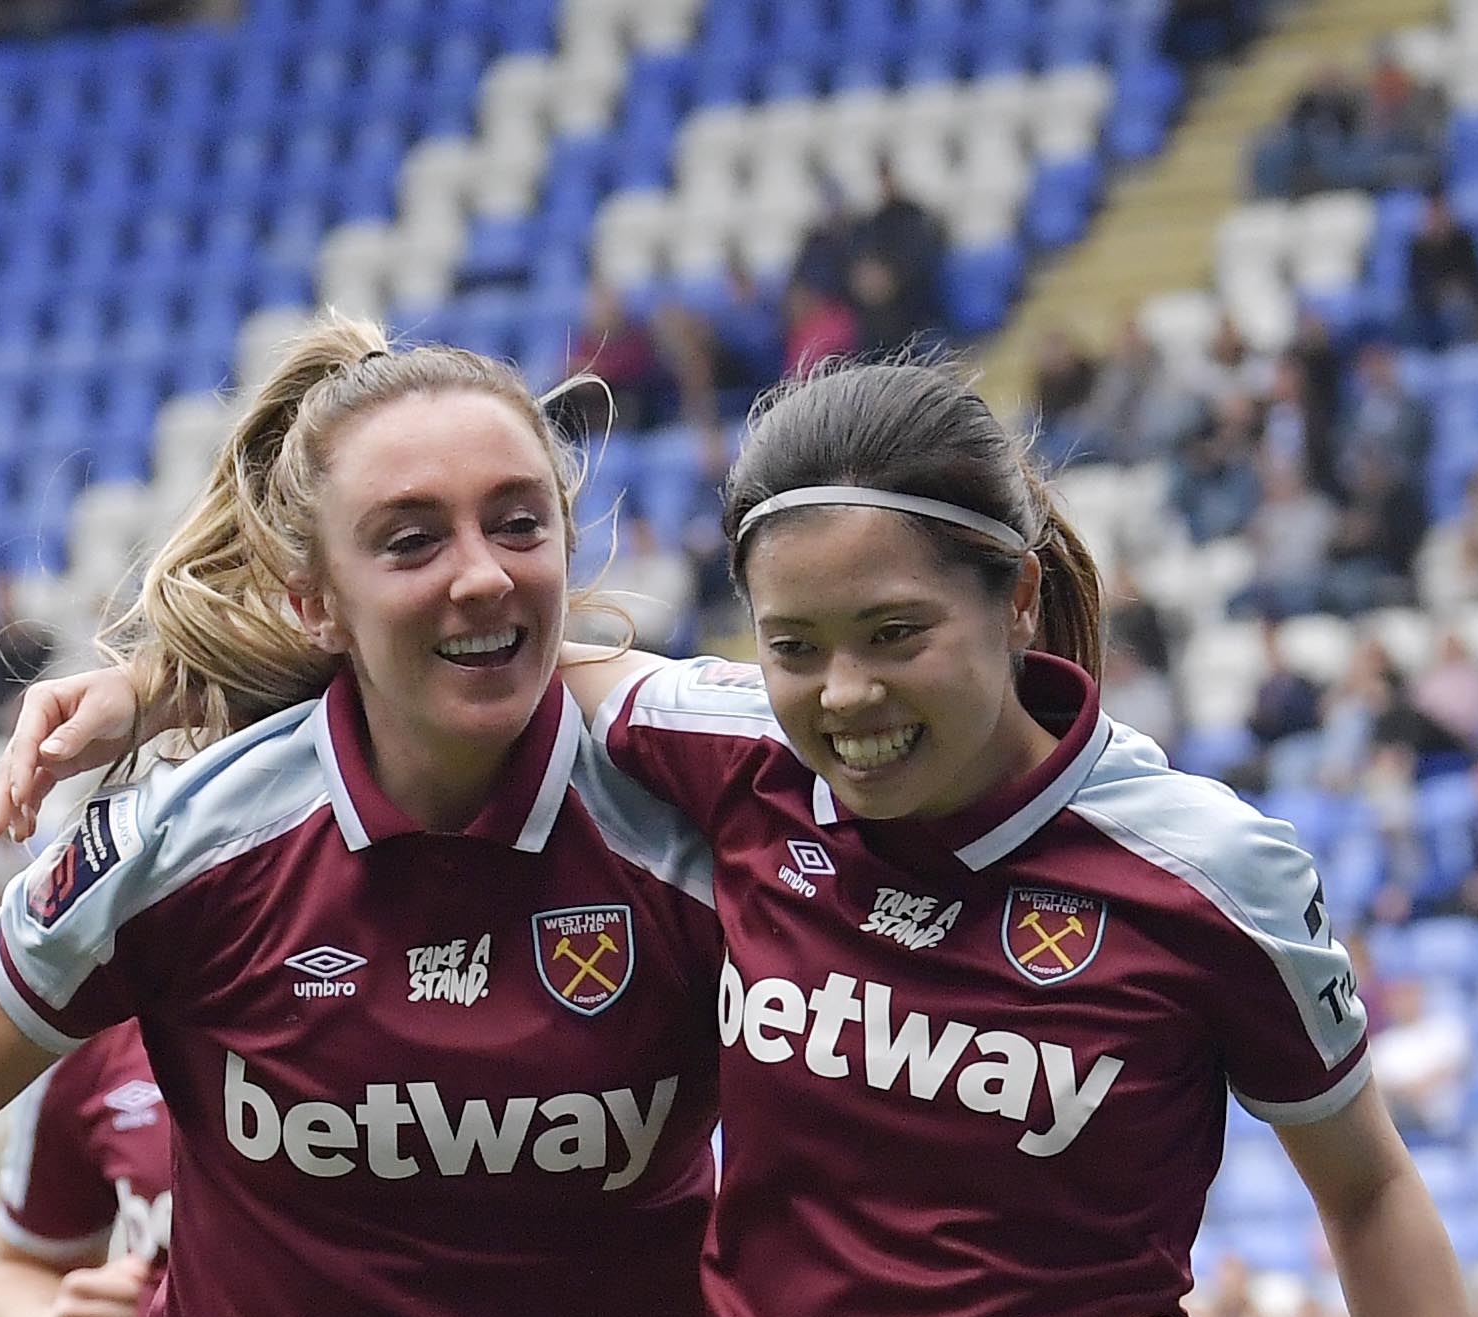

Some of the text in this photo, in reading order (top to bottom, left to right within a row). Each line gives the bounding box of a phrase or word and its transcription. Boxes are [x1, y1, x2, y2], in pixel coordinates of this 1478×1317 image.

[778, 865, 817, 898] umbro
[874, 888, 963, 930] TAKE A
[1019, 892, 1094, 909] WEST HAM
[1033, 902, 1077, 914] UNITED
[544, 912, 620, 929] WEST HAM
[561, 923, 604, 935] UNITED
[406, 933, 491, 974] TAKE A
[1027, 963, 1062, 974] LONDON
[293, 979, 356, 998] umbro
[407, 963, 489, 1007] STAND.
[573, 991, 608, 1004] LONDON
[718, 947, 1124, 1157] betway
[224, 1049, 680, 1191] betway
